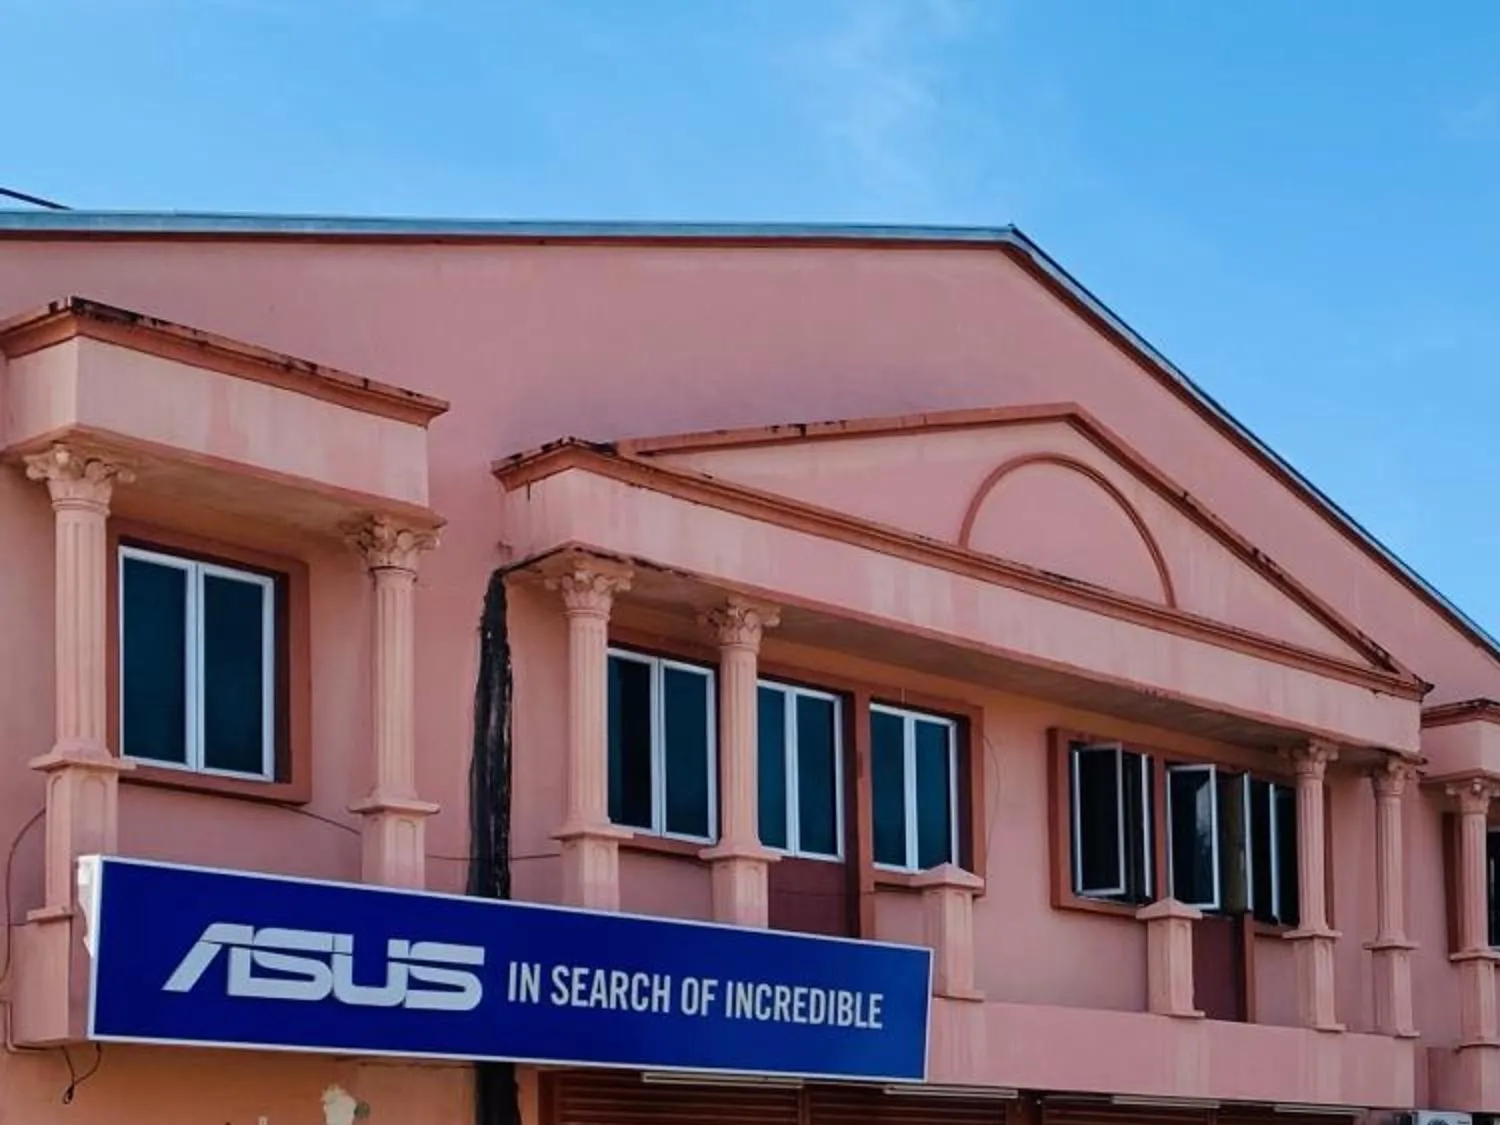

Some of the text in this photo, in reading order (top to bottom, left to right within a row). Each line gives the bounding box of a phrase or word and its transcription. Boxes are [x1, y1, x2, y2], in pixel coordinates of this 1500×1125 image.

[163, 923, 883, 1029] ASUS IN SEARCH OF INCREDIBLE
